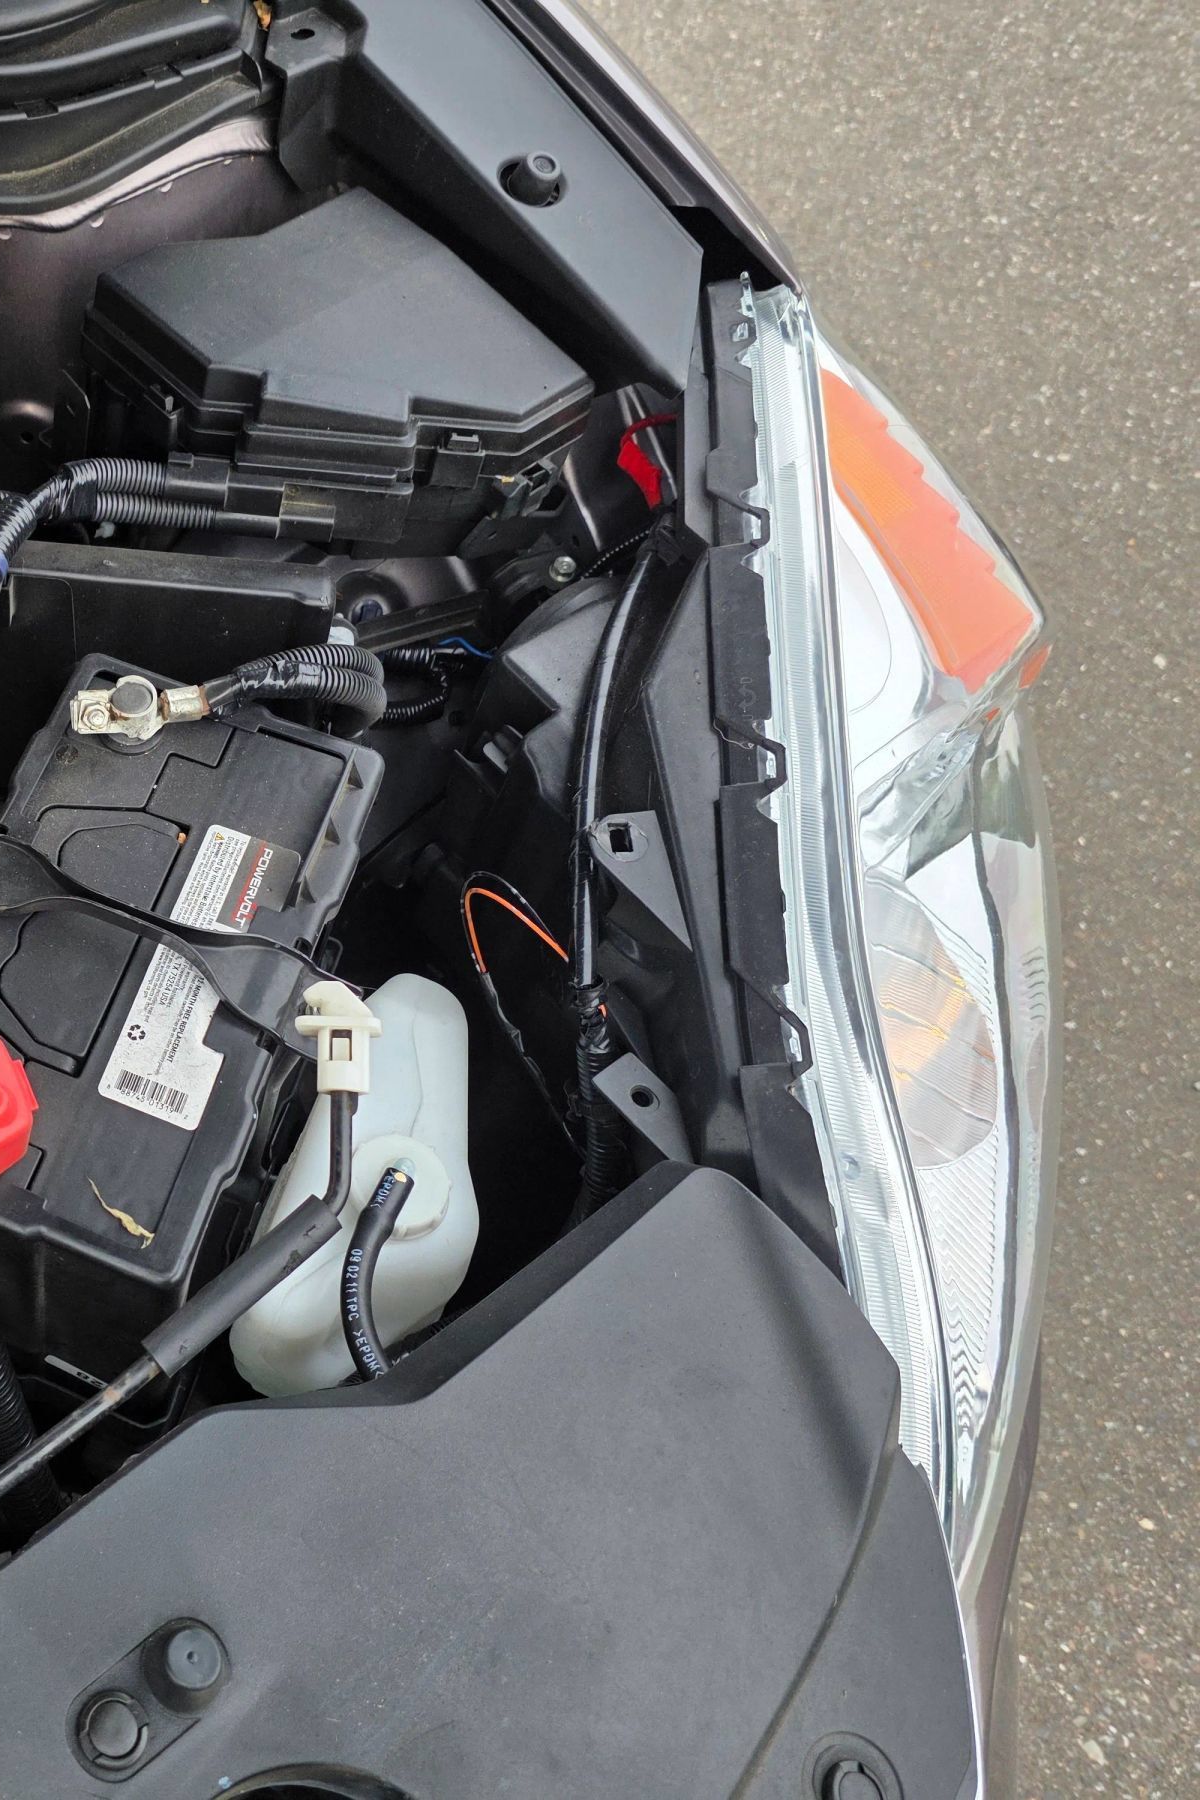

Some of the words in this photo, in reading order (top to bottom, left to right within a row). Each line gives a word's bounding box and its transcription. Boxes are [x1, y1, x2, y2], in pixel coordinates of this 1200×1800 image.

[212, 866, 221, 874] by
[236, 848, 273, 926] POWERVOLT
[172, 962, 181, 971] TX
[164, 971, 177, 992] 75254
[158, 992, 169, 1006] USA
[182, 1006, 193, 1020] FREE
[167, 1020, 187, 1062] REPLACEMENT
[148, 1098, 174, 1113] 01319
[349, 1248, 363, 1263] 09
[346, 1265, 359, 1278] 02
[346, 1296, 360, 1321] TPC
